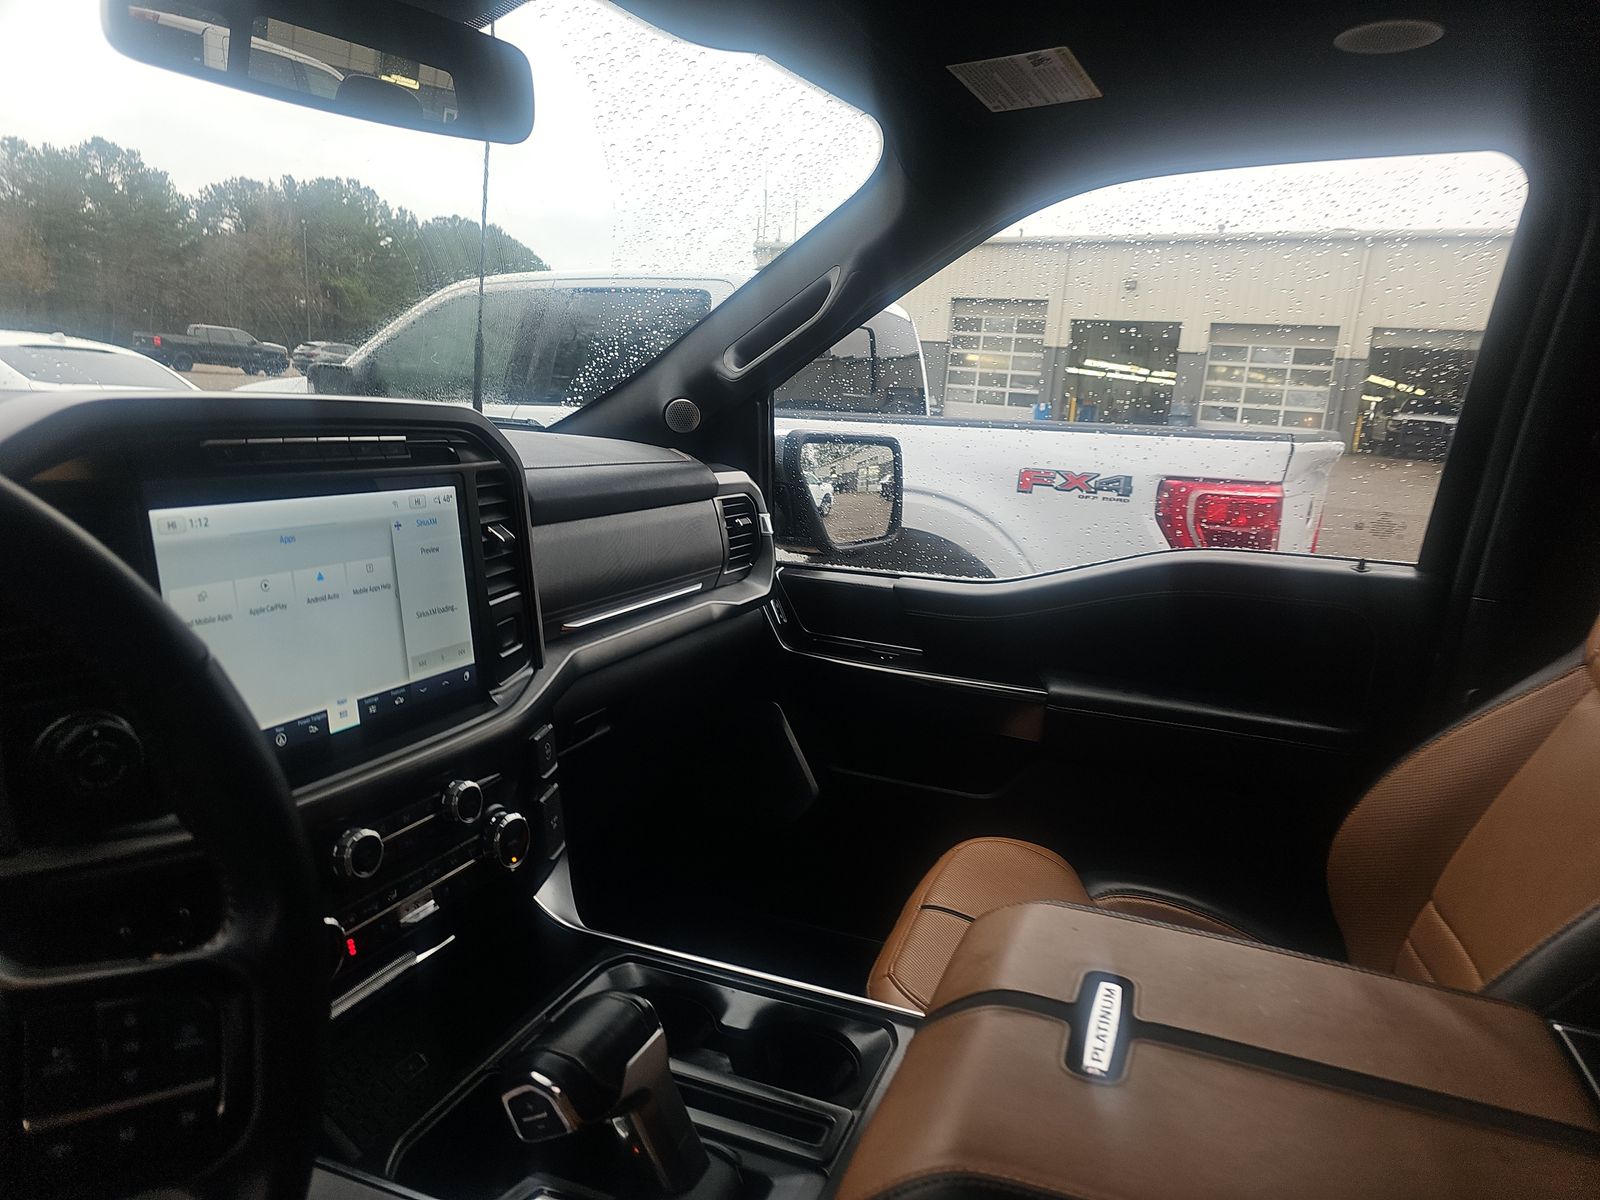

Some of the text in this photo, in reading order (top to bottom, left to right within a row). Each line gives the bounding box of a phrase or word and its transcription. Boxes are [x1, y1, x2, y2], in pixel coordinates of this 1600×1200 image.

[1016, 467, 1133, 497] FX4
[189, 517, 209, 529] 1:12
[415, 517, 437, 527] SiriusXM
[279, 535, 296, 545] Apps
[420, 546, 440, 555] Preview
[352, 583, 392, 595] Mobile Apps Help
[306, 592, 340, 604] Android Auto
[249, 602, 288, 616] Apple CarPlay
[217, 613, 233, 624] Apps
[1090, 986, 1116, 1063] PLATINUM
